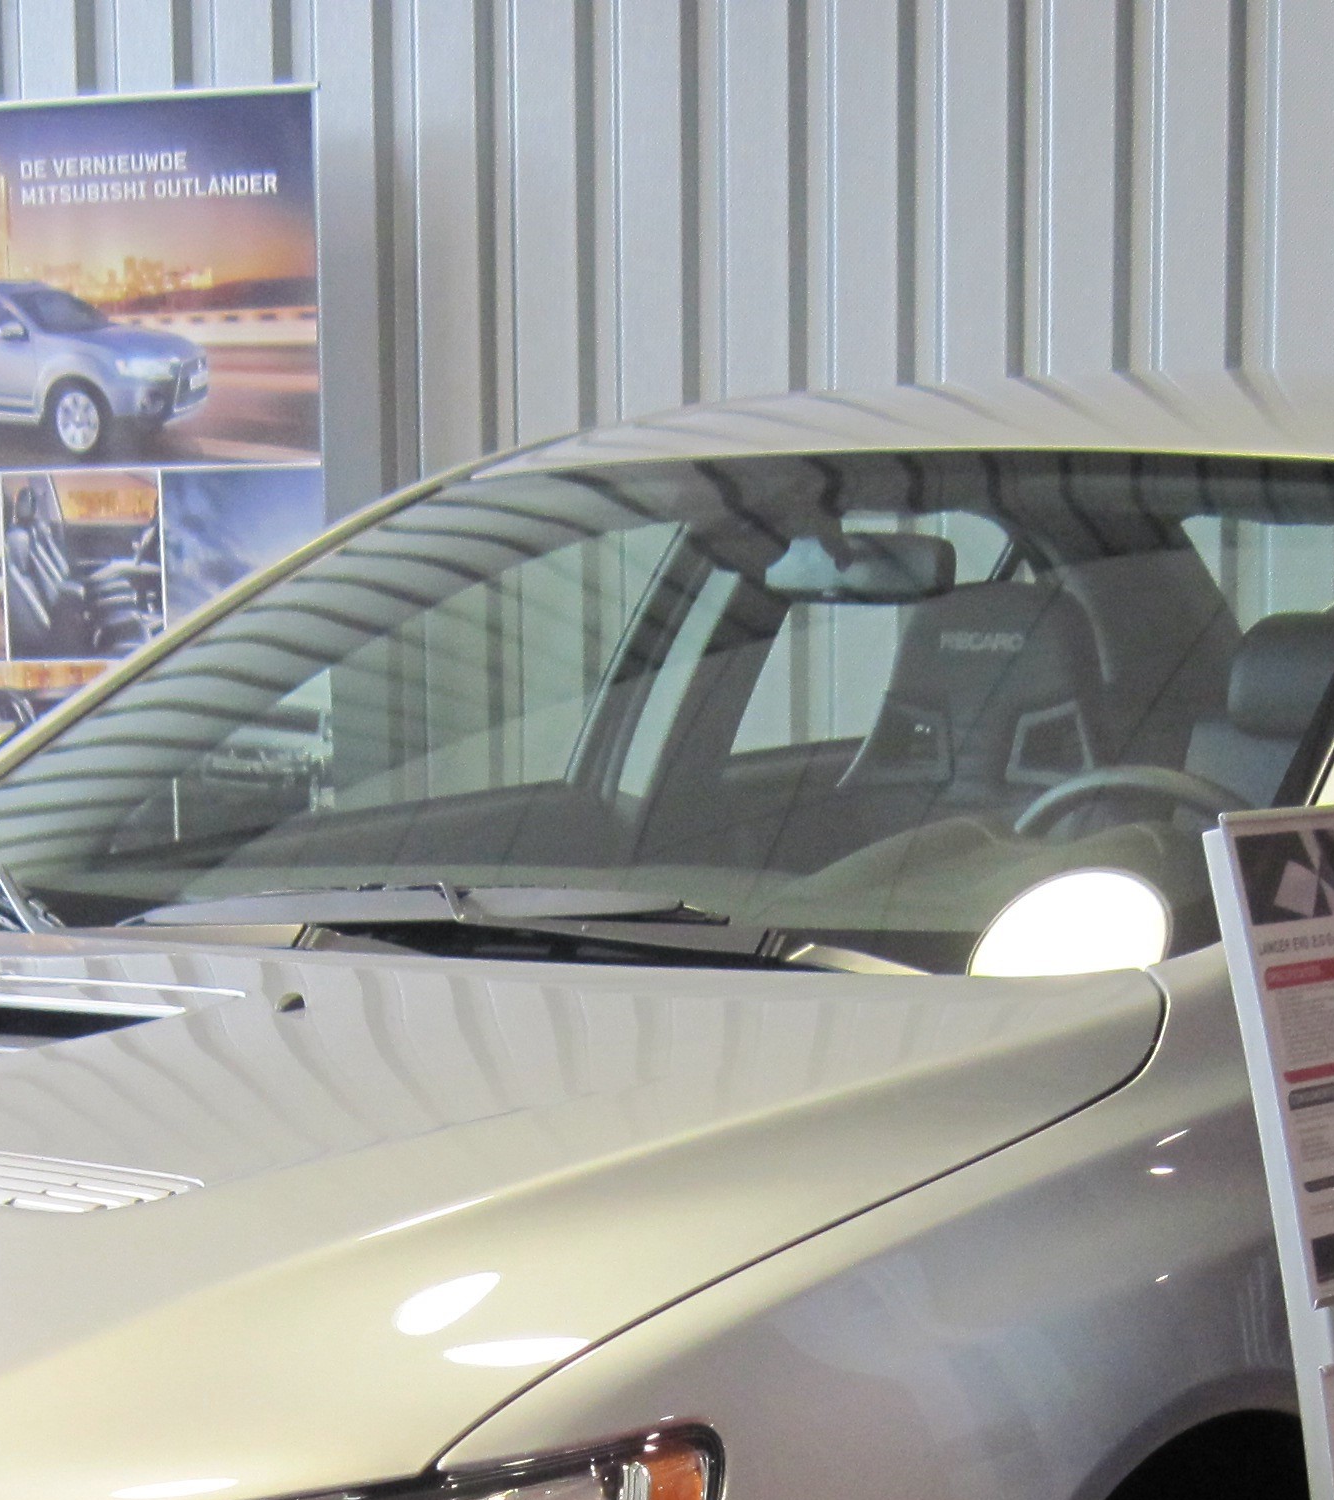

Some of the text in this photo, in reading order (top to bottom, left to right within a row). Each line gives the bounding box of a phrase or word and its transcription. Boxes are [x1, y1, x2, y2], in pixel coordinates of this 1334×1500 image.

[20, 150, 188, 180] DE VERNIEUWDE
[21, 171, 278, 206] MITSUBISHI OUTLANDER
